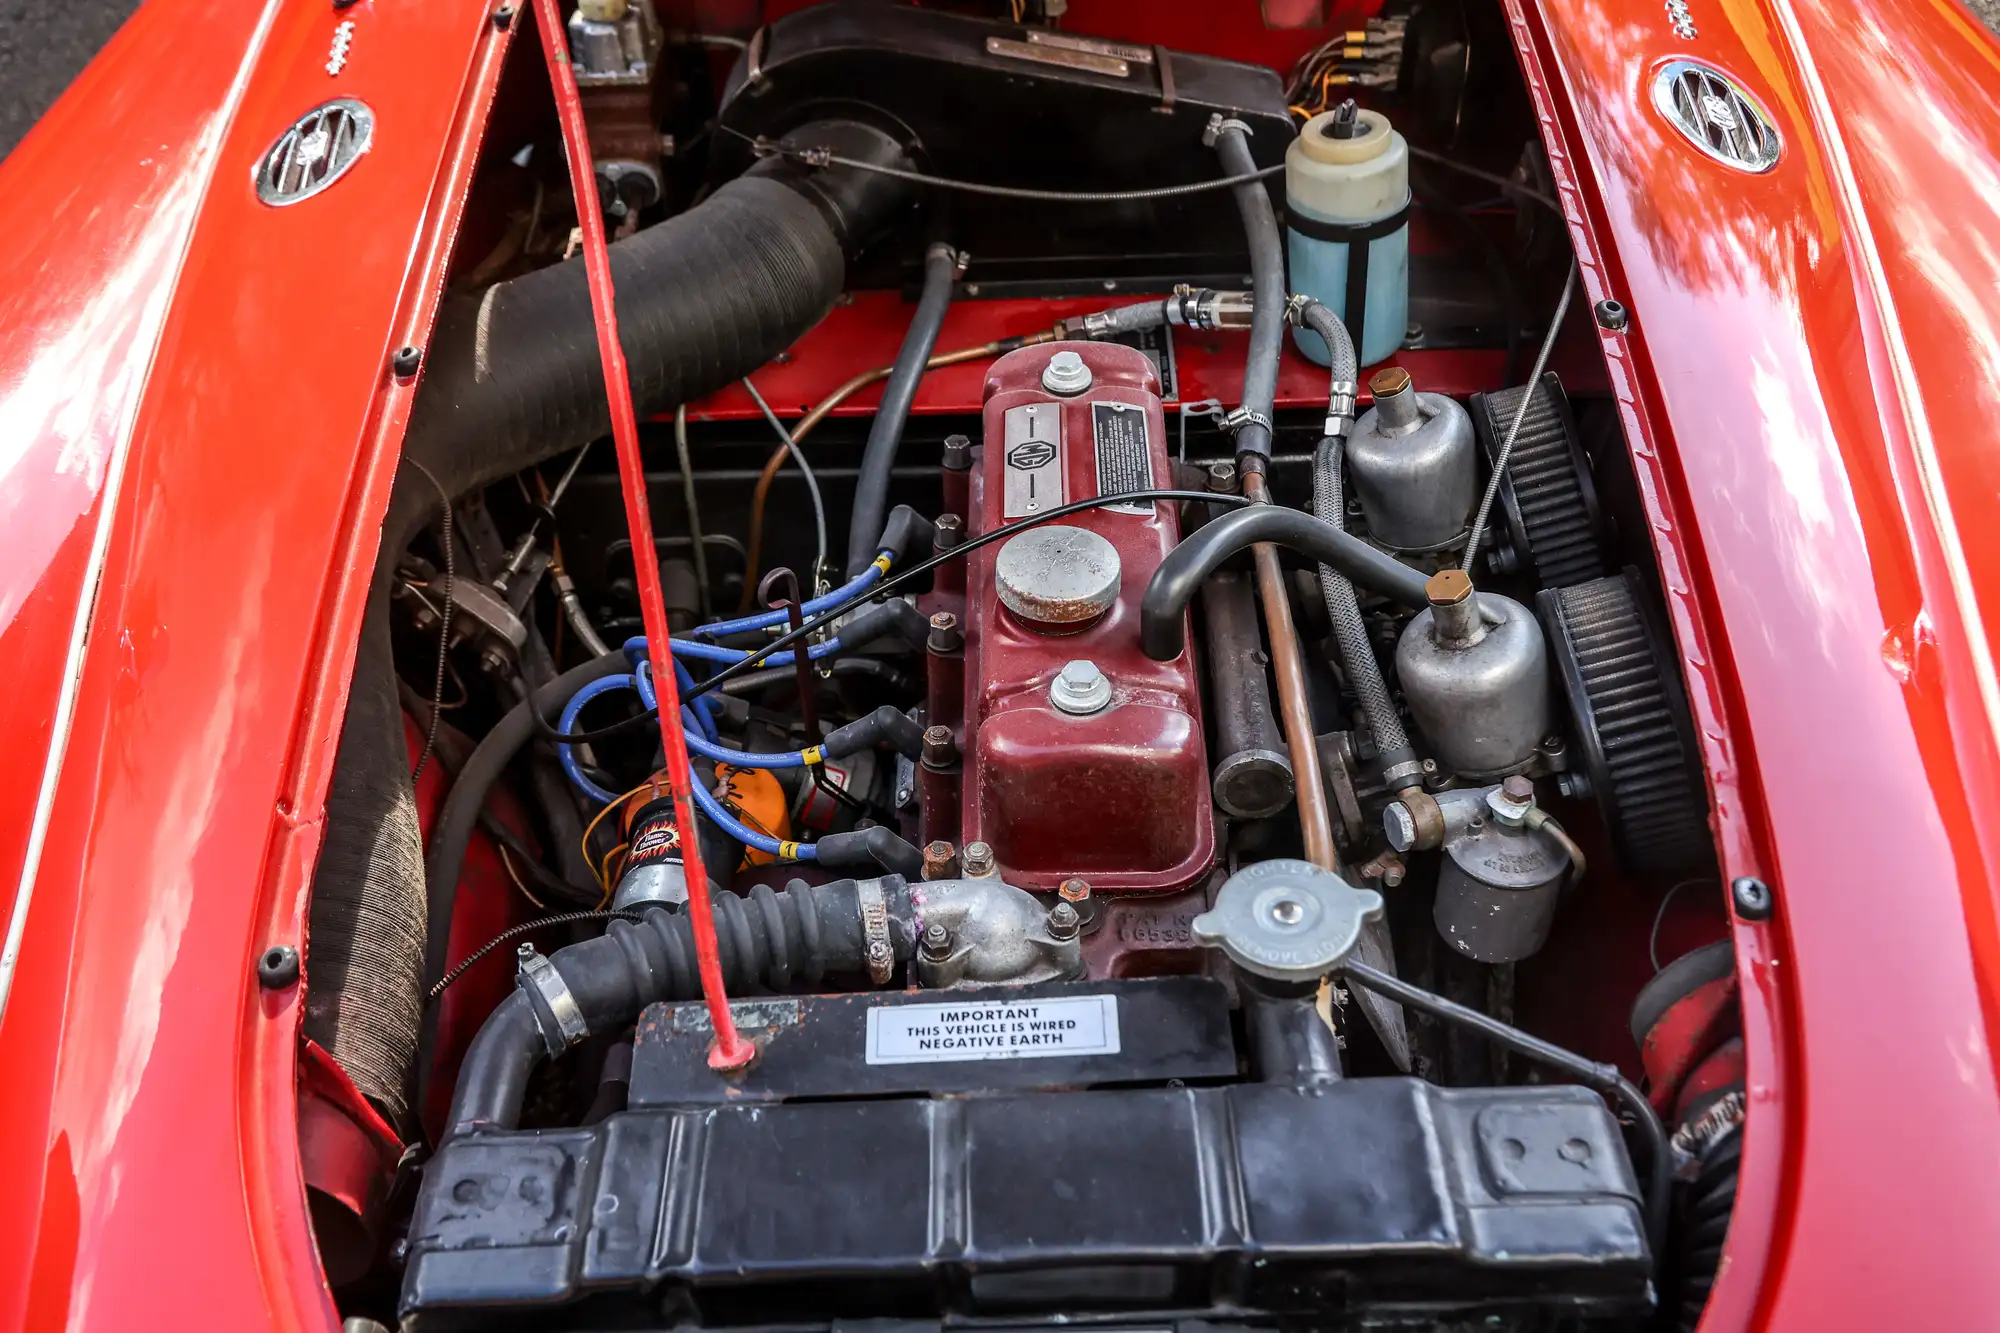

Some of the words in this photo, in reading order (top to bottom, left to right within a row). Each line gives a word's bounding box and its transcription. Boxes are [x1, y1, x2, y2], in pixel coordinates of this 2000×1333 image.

[1013, 443, 1051, 467] MG
[940, 1007, 1039, 1022] IMPORTANT
[907, 1026, 940, 1036] THIS
[945, 1023, 1007, 1035] VEHICLE
[1011, 1022, 1025, 1032] IS
[1026, 1020, 1077, 1031] WIRED
[919, 1036, 1005, 1050] NEGATIVE
[1010, 1033, 1063, 1046] EARTH
